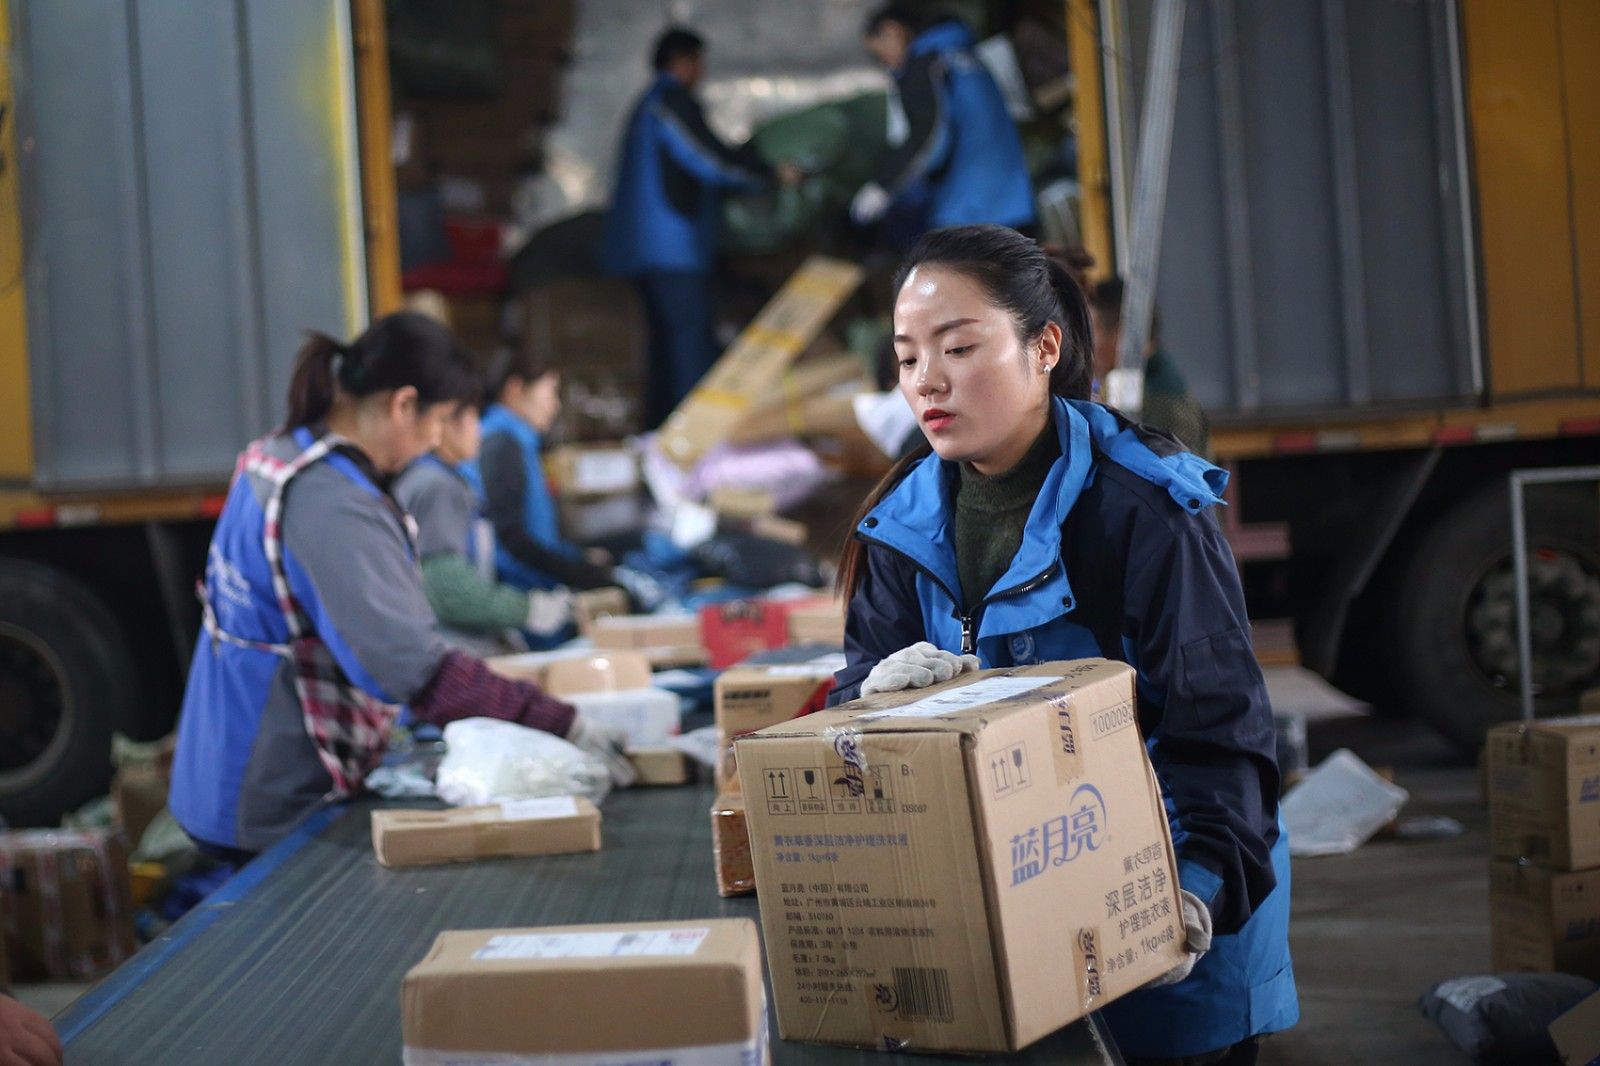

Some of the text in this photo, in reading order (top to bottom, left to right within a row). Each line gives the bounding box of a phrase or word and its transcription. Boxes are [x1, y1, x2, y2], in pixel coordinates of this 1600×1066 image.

[1010, 803, 1103, 887] 蓝月亮
[1122, 841, 1162, 875] 薰衣草香
[1105, 866, 1167, 919] 深层洁净
[1119, 897, 1171, 940] 护理洗衣液
